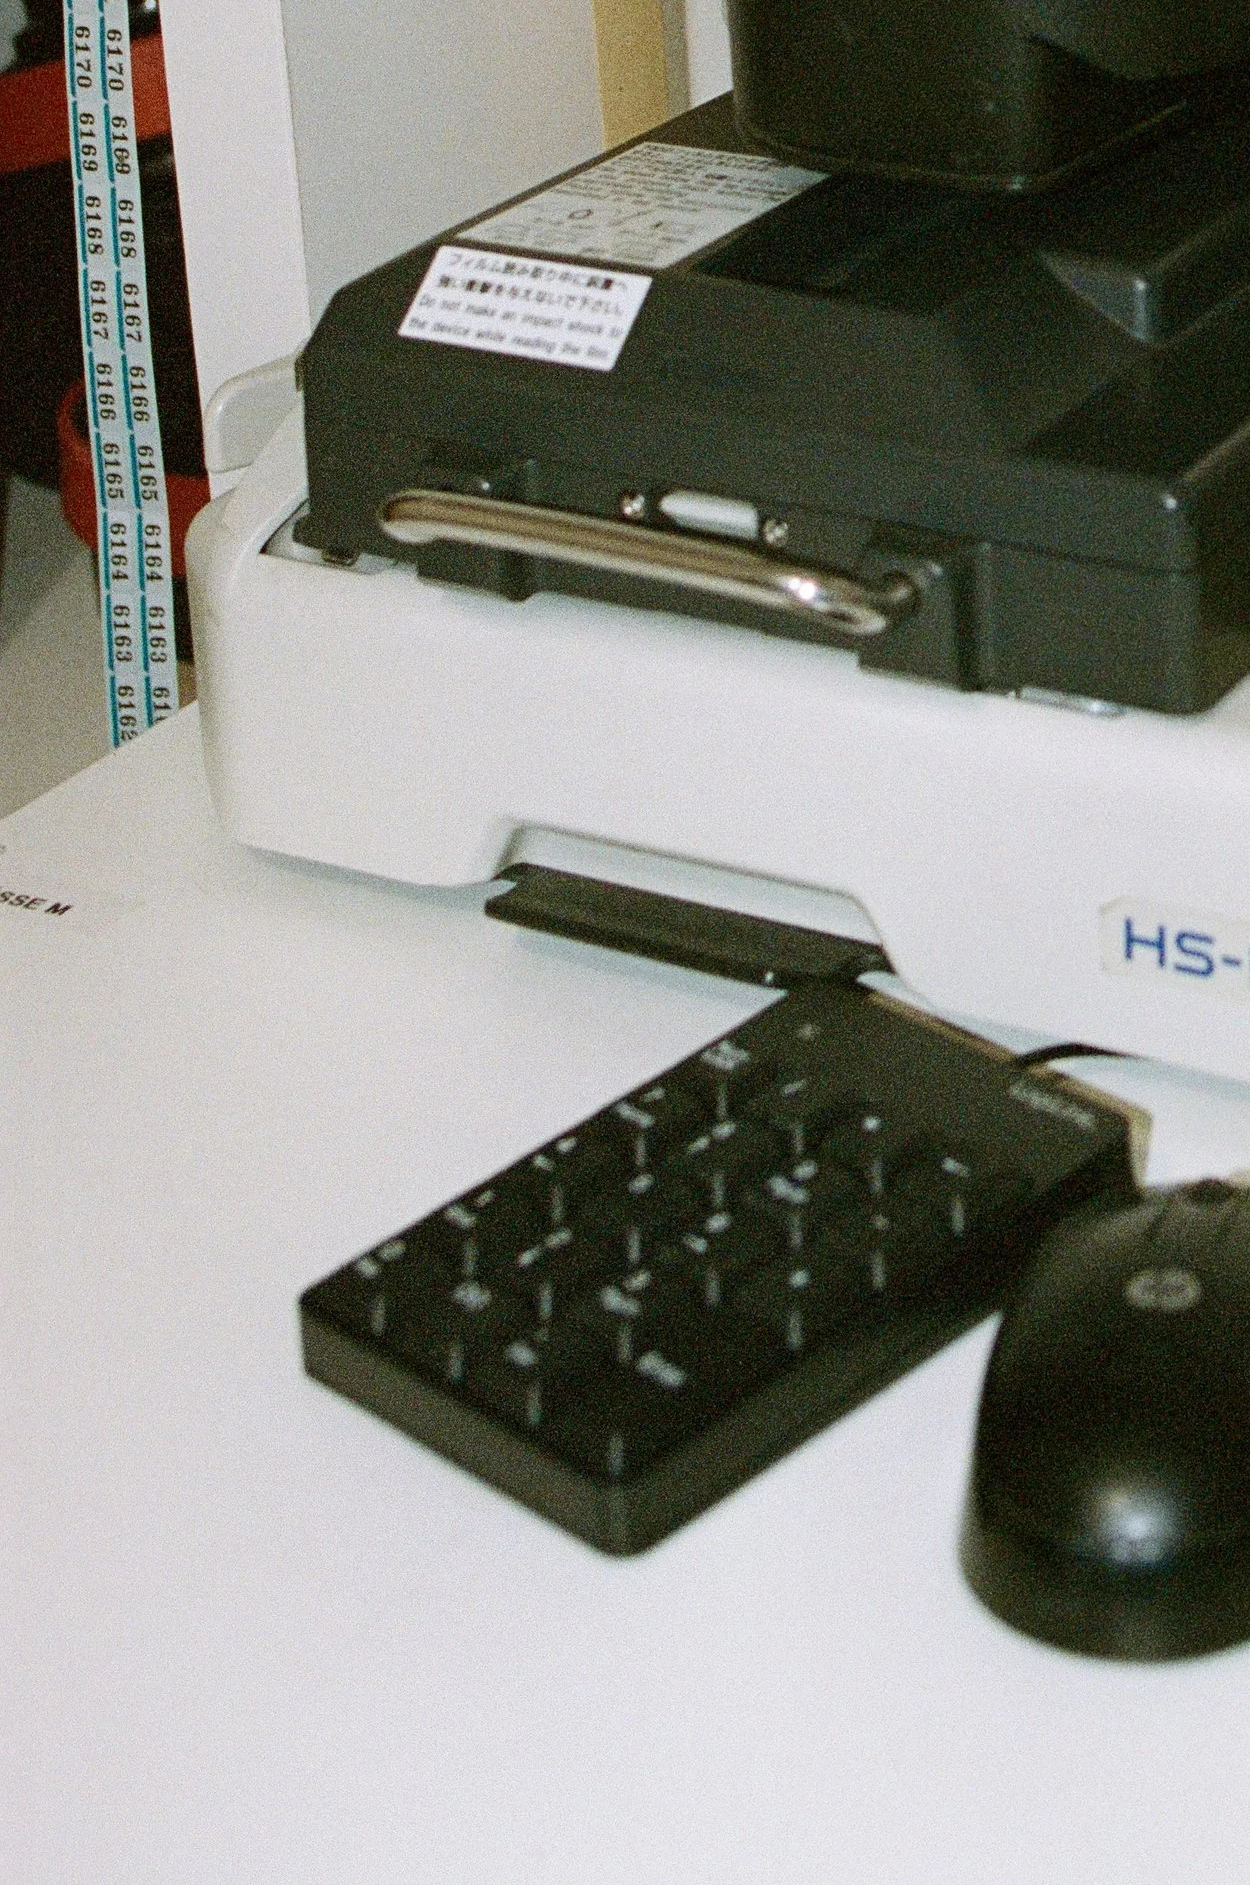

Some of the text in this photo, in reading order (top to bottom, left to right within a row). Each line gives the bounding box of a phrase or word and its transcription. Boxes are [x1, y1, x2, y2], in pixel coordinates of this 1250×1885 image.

[74, 25, 92, 89] 6170
[106, 28, 124, 92] 6170
[78, 112, 99, 172] 6169
[85, 195, 103, 255] 6168
[117, 199, 137, 258] 6168
[90, 280, 109, 340] 6167
[122, 283, 142, 343] 6167
[95, 363, 117, 421] 6166
[128, 365, 151, 422] 6166
[102, 442, 125, 500] 6165
[136, 445, 160, 501] 6165
[109, 522, 129, 581] 6164
[144, 524, 164, 582] 6164
[112, 604, 133, 663] 6163
[147, 606, 167, 664] 6163
[0, 890, 75, 916] SSE M
